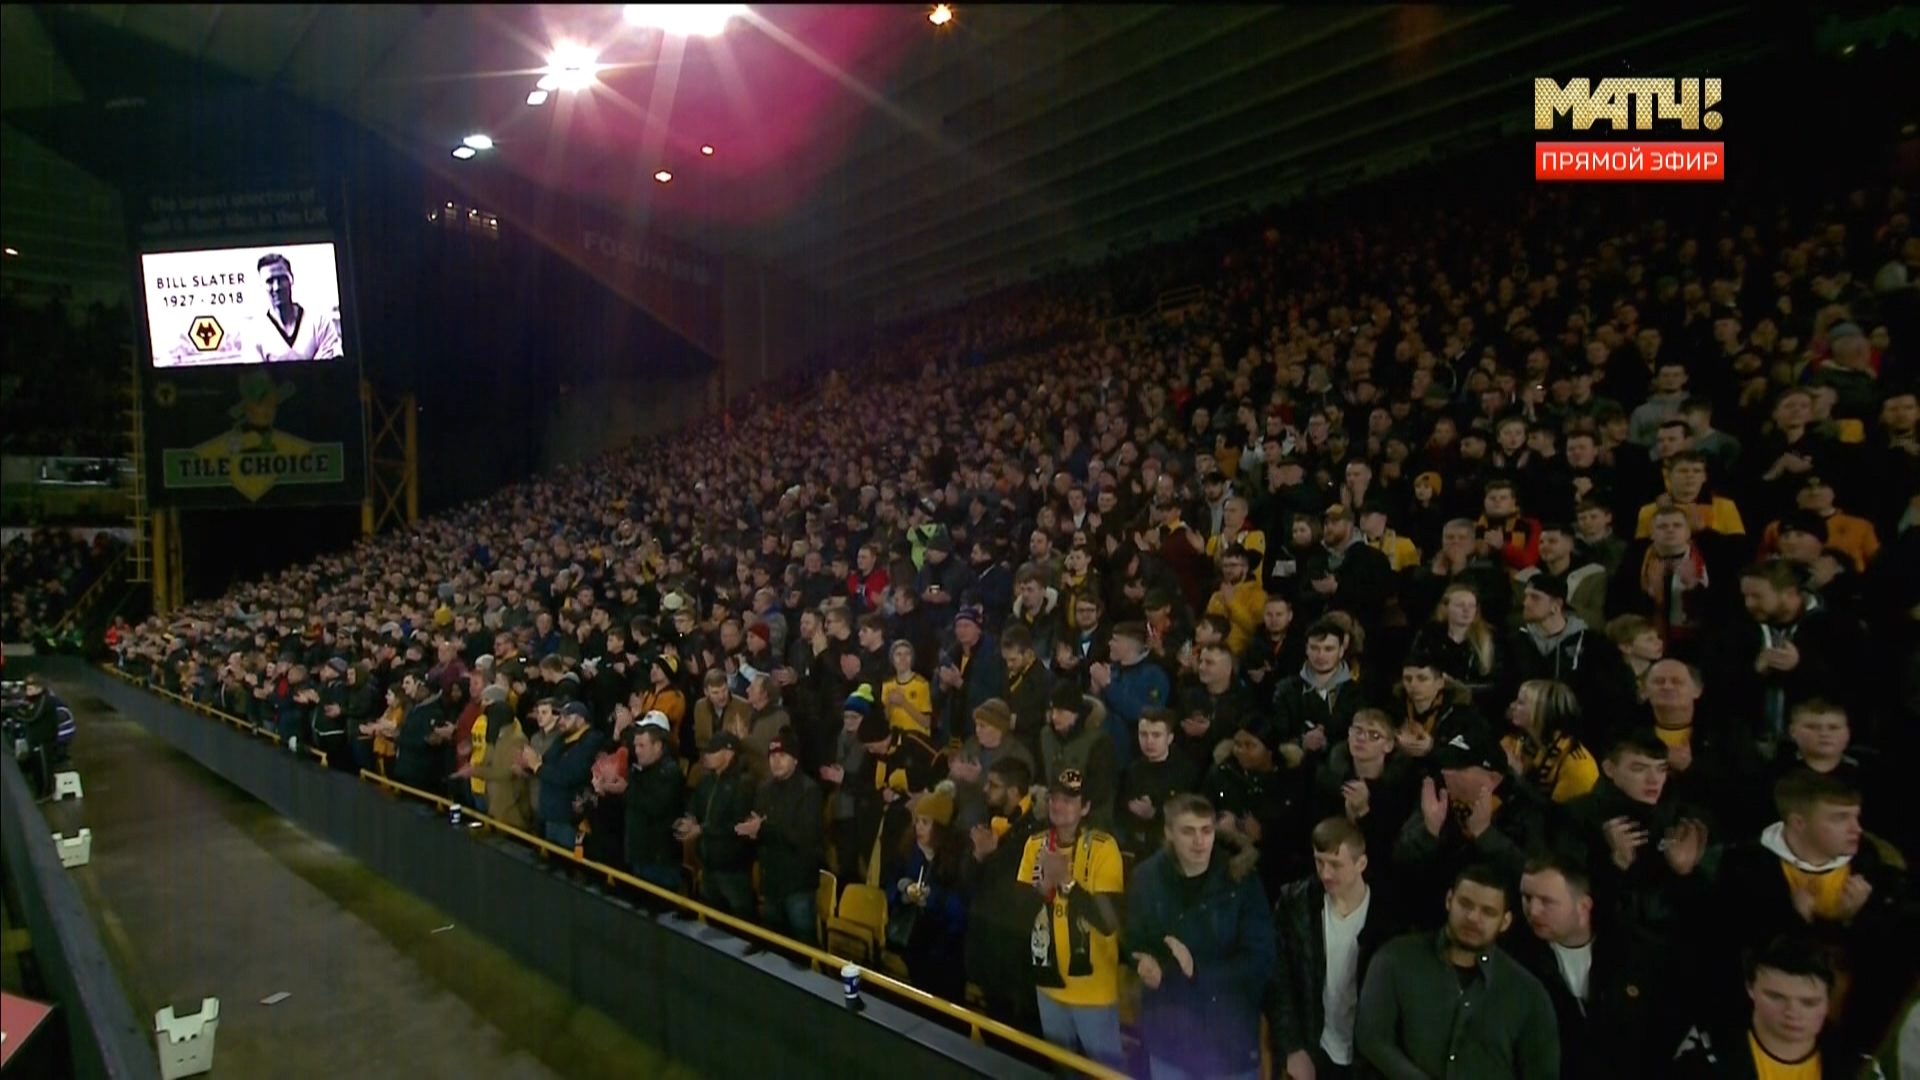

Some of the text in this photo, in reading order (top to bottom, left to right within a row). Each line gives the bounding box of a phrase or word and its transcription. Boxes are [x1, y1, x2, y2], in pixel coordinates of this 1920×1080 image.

[583, 230, 669, 274] FOSUN
[156, 272, 246, 290] BILL SLATER
[163, 294, 195, 308] 1927
[210, 291, 244, 305] 2018
[178, 453, 329, 477] TILE CHOICE
